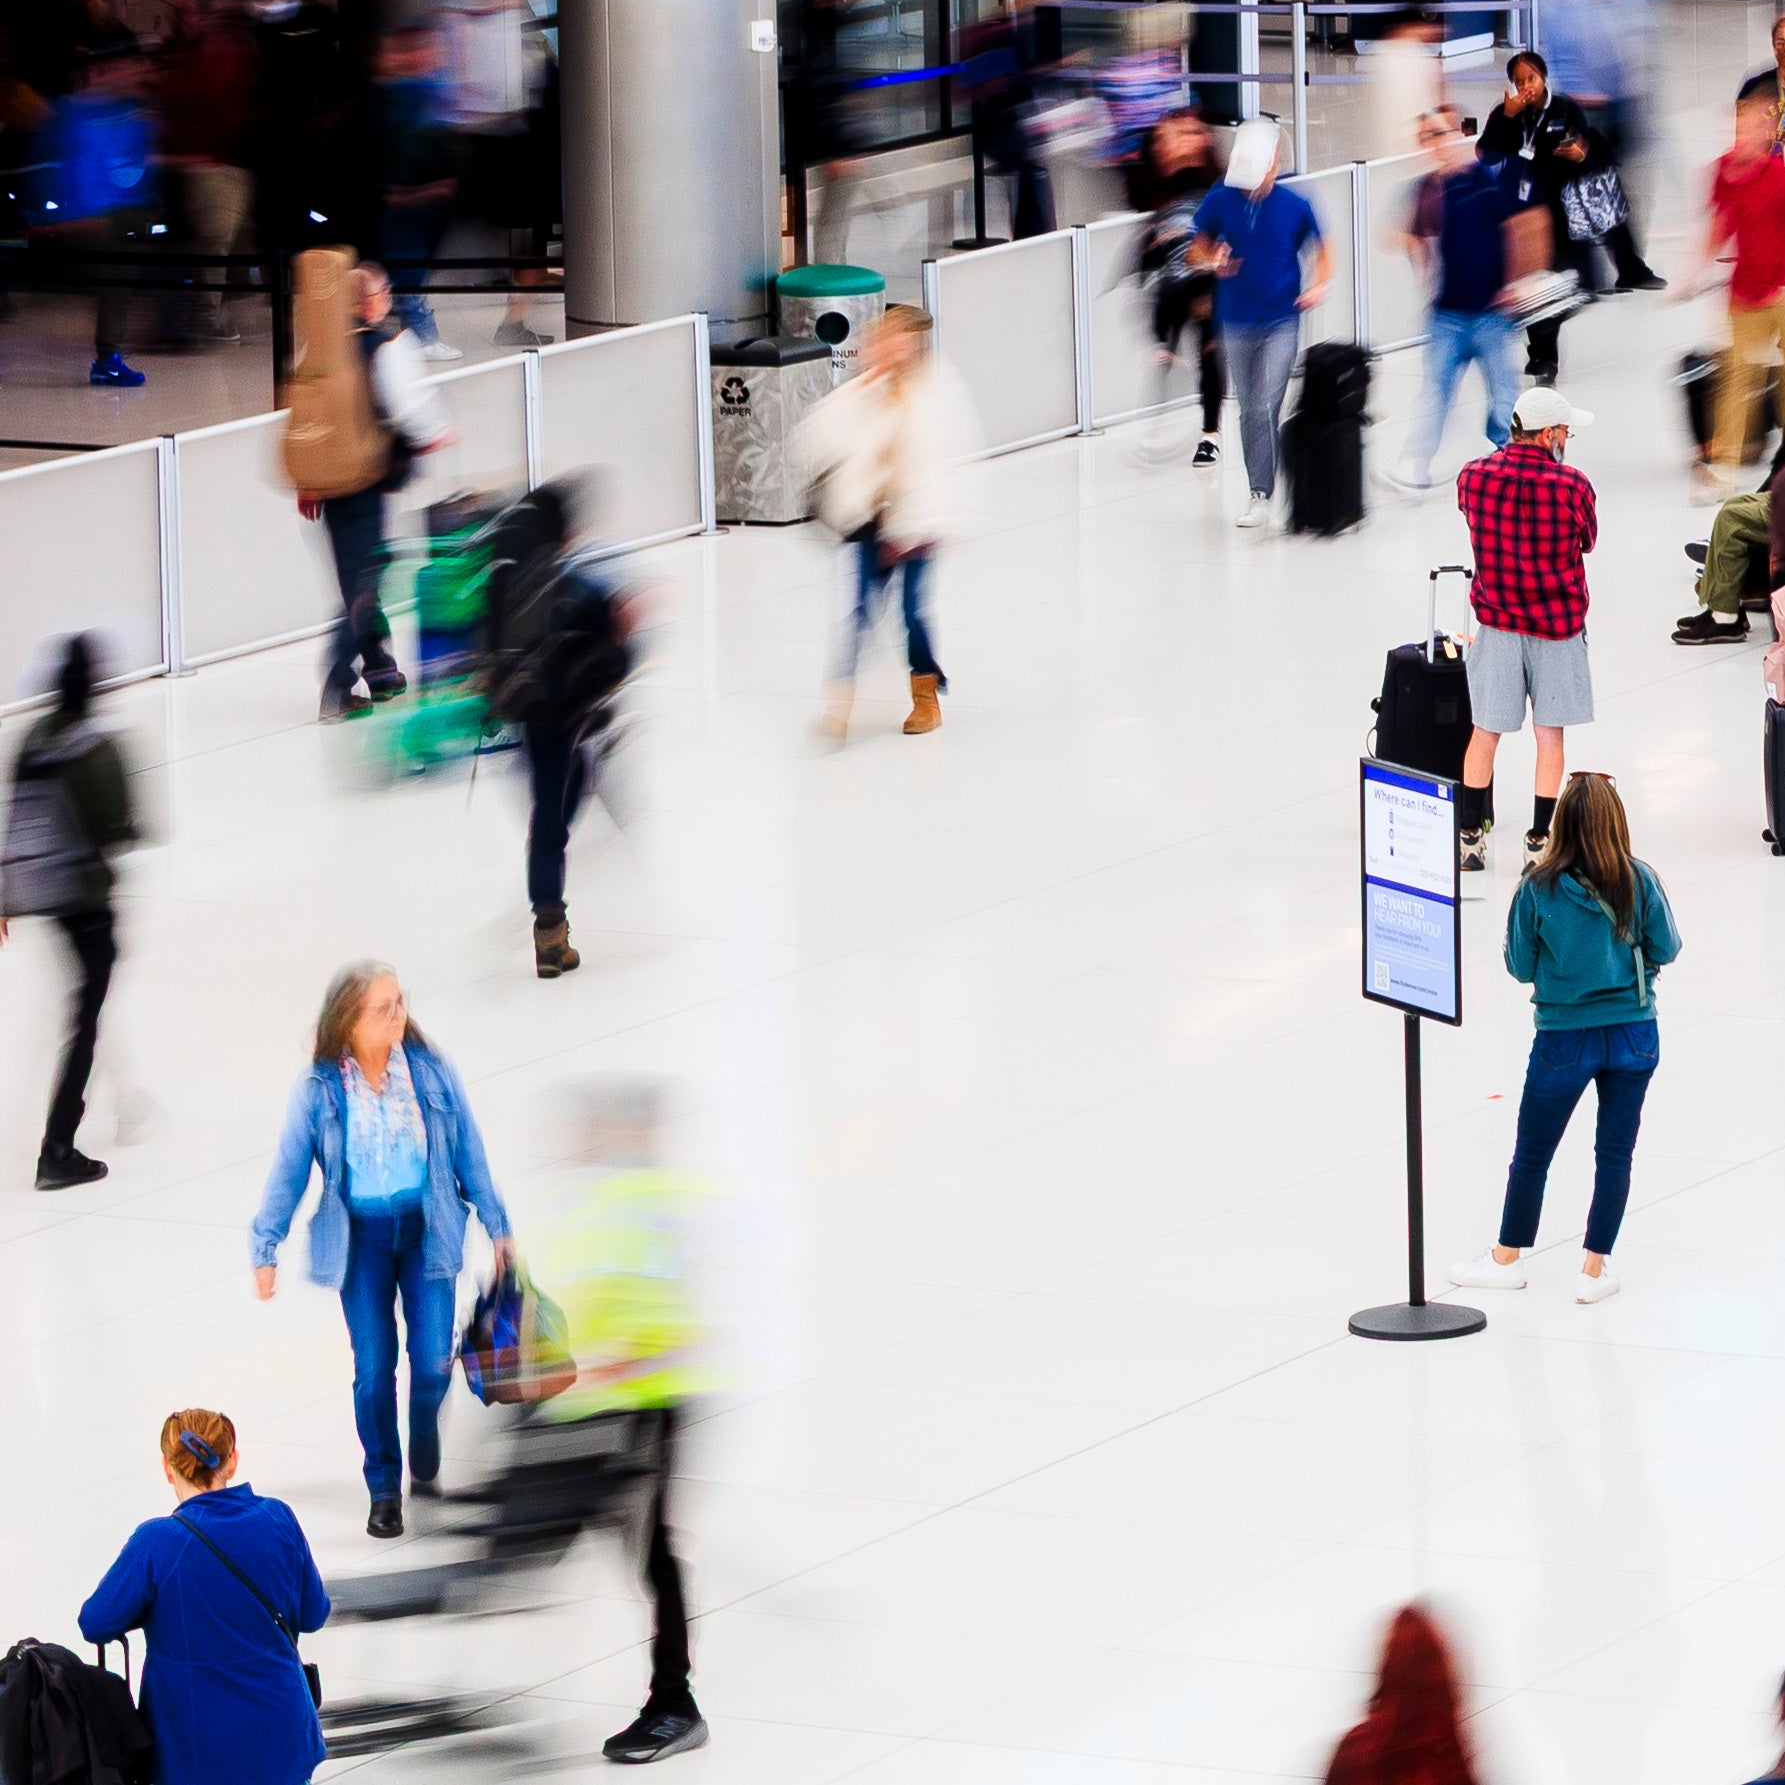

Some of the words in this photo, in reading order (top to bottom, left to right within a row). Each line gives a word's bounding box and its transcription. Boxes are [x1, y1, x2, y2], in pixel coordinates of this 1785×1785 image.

[720, 407, 751, 416] PAPER
[1374, 788, 1398, 805] Where
[1401, 798, 1416, 810] can
